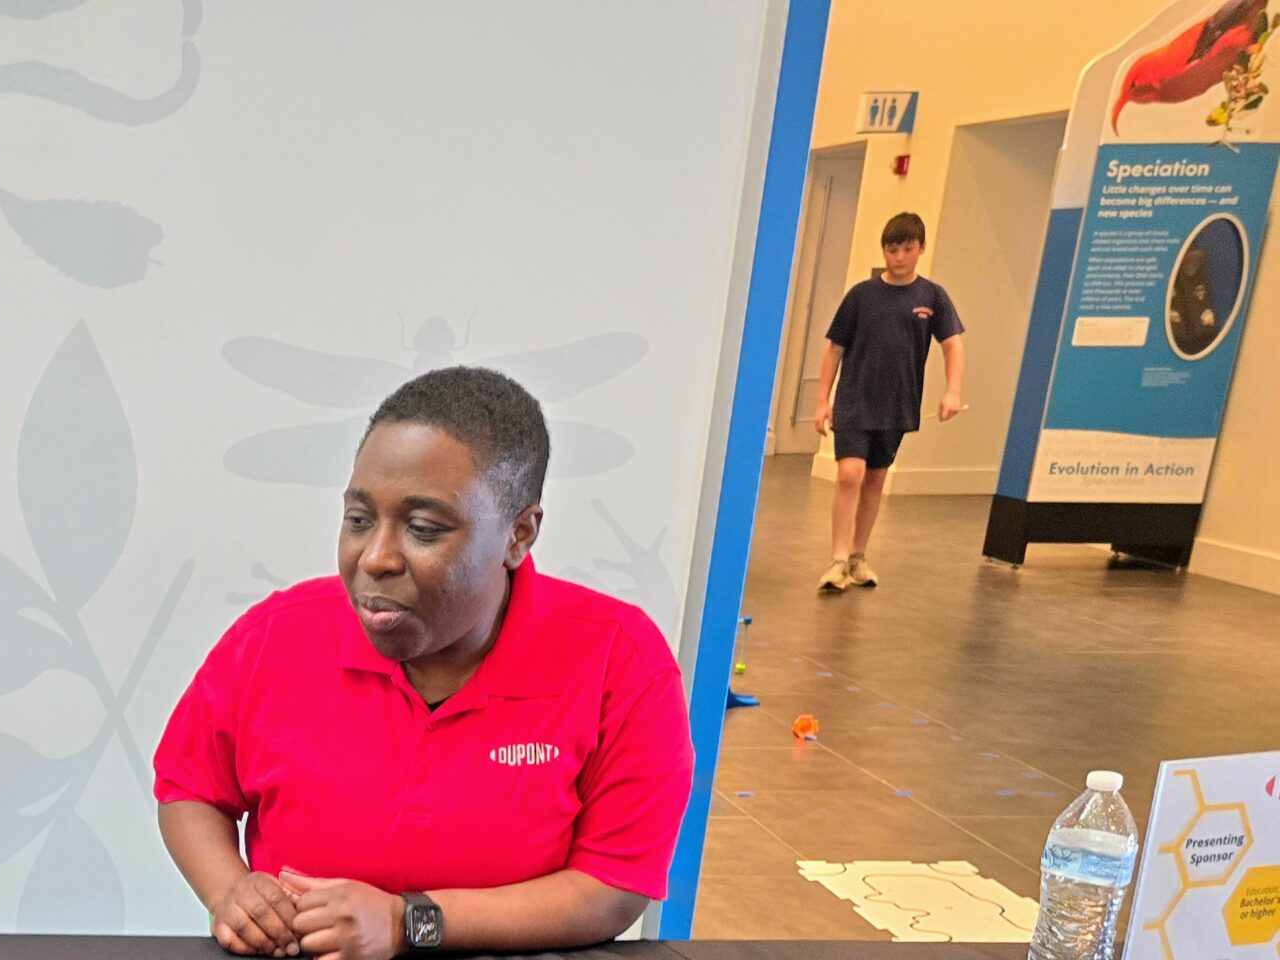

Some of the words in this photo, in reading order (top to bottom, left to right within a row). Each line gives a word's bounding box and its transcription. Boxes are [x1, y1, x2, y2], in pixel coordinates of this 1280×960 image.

[1106, 159, 1210, 183] Speciation
[1102, 184, 1127, 194] Little
[1128, 185, 1167, 195] changes
[1168, 185, 1189, 193] over
[1191, 184, 1213, 193] time
[1214, 185, 1233, 193] can
[1100, 197, 1137, 206] become
[1138, 197, 1153, 208] big
[1154, 196, 1206, 206] differences
[1219, 196, 1239, 205] and
[1098, 210, 1118, 218] new
[1119, 209, 1153, 219] species
[1048, 462, 1120, 476] Evolution
[1125, 462, 1140, 476] in
[1144, 463, 1195, 477] Action
[498, 742, 553, 766] DUPONT
[1185, 833, 1245, 849] Presenting
[1189, 851, 1234, 867] Sponsor
[1240, 910, 1249, 919] or
[1250, 908, 1276, 920] higher
